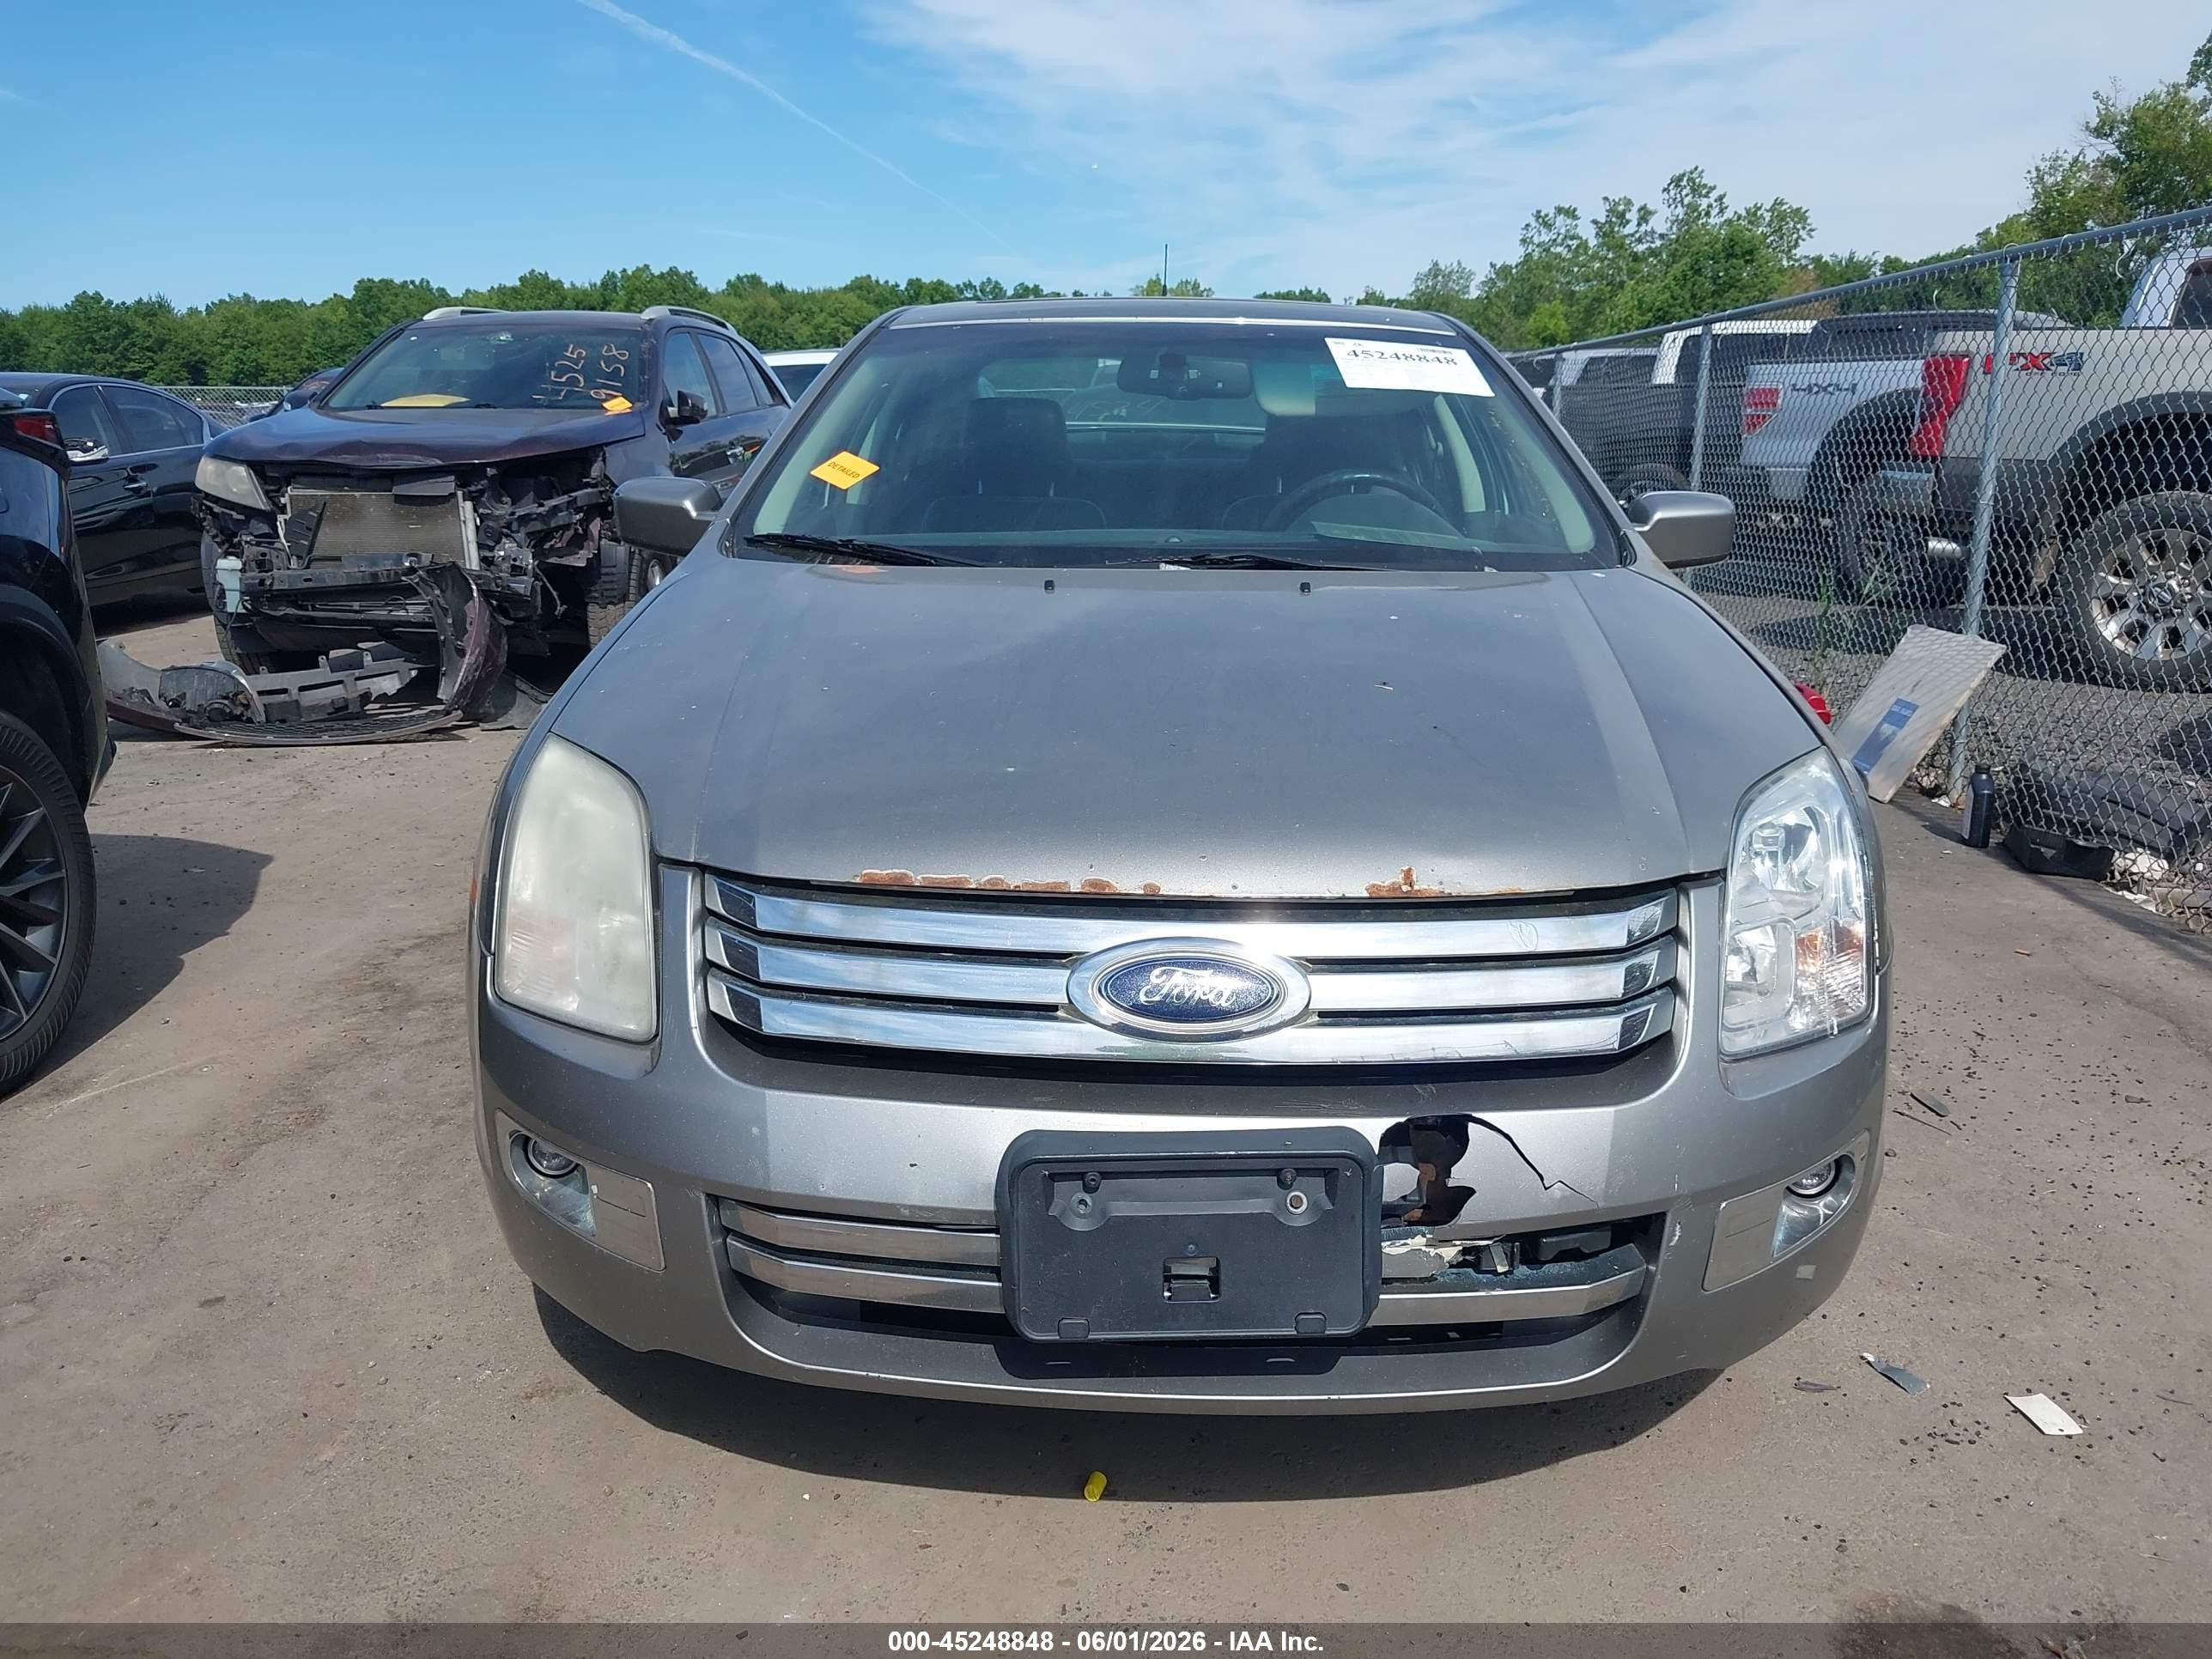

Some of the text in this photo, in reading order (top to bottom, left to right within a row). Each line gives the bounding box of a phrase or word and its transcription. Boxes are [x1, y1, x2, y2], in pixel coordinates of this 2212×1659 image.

[590, 343, 629, 398] 9158
[1347, 349, 1458, 366] 45248848
[827, 461, 861, 479] DETAILED
[1139, 966, 1253, 1006] Ford
